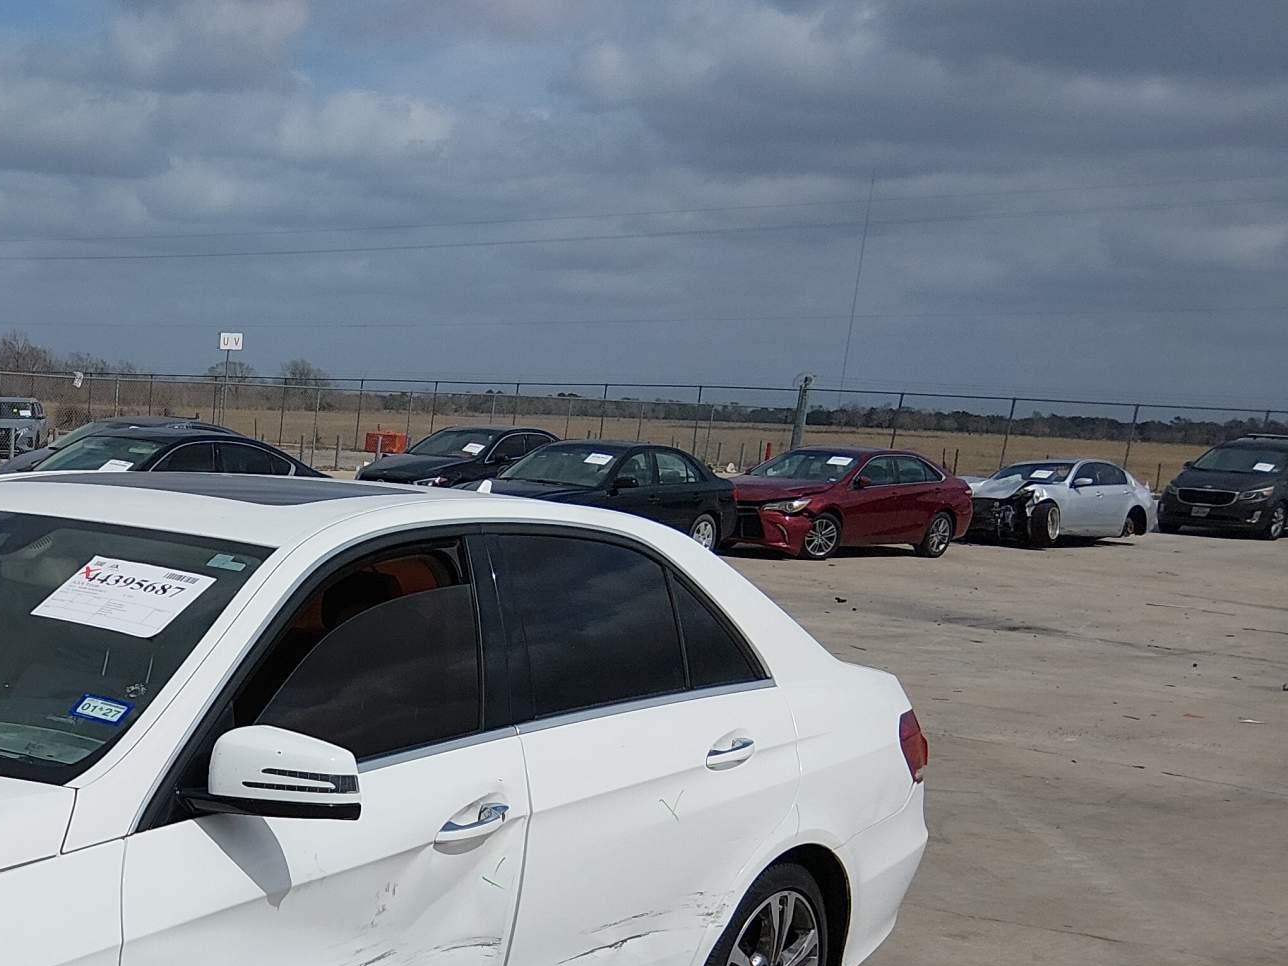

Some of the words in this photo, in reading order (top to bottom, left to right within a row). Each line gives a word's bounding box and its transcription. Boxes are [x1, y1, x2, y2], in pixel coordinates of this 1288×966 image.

[223, 336, 229, 346] U
[233, 336, 240, 346] V
[86, 571, 187, 598] 44395687
